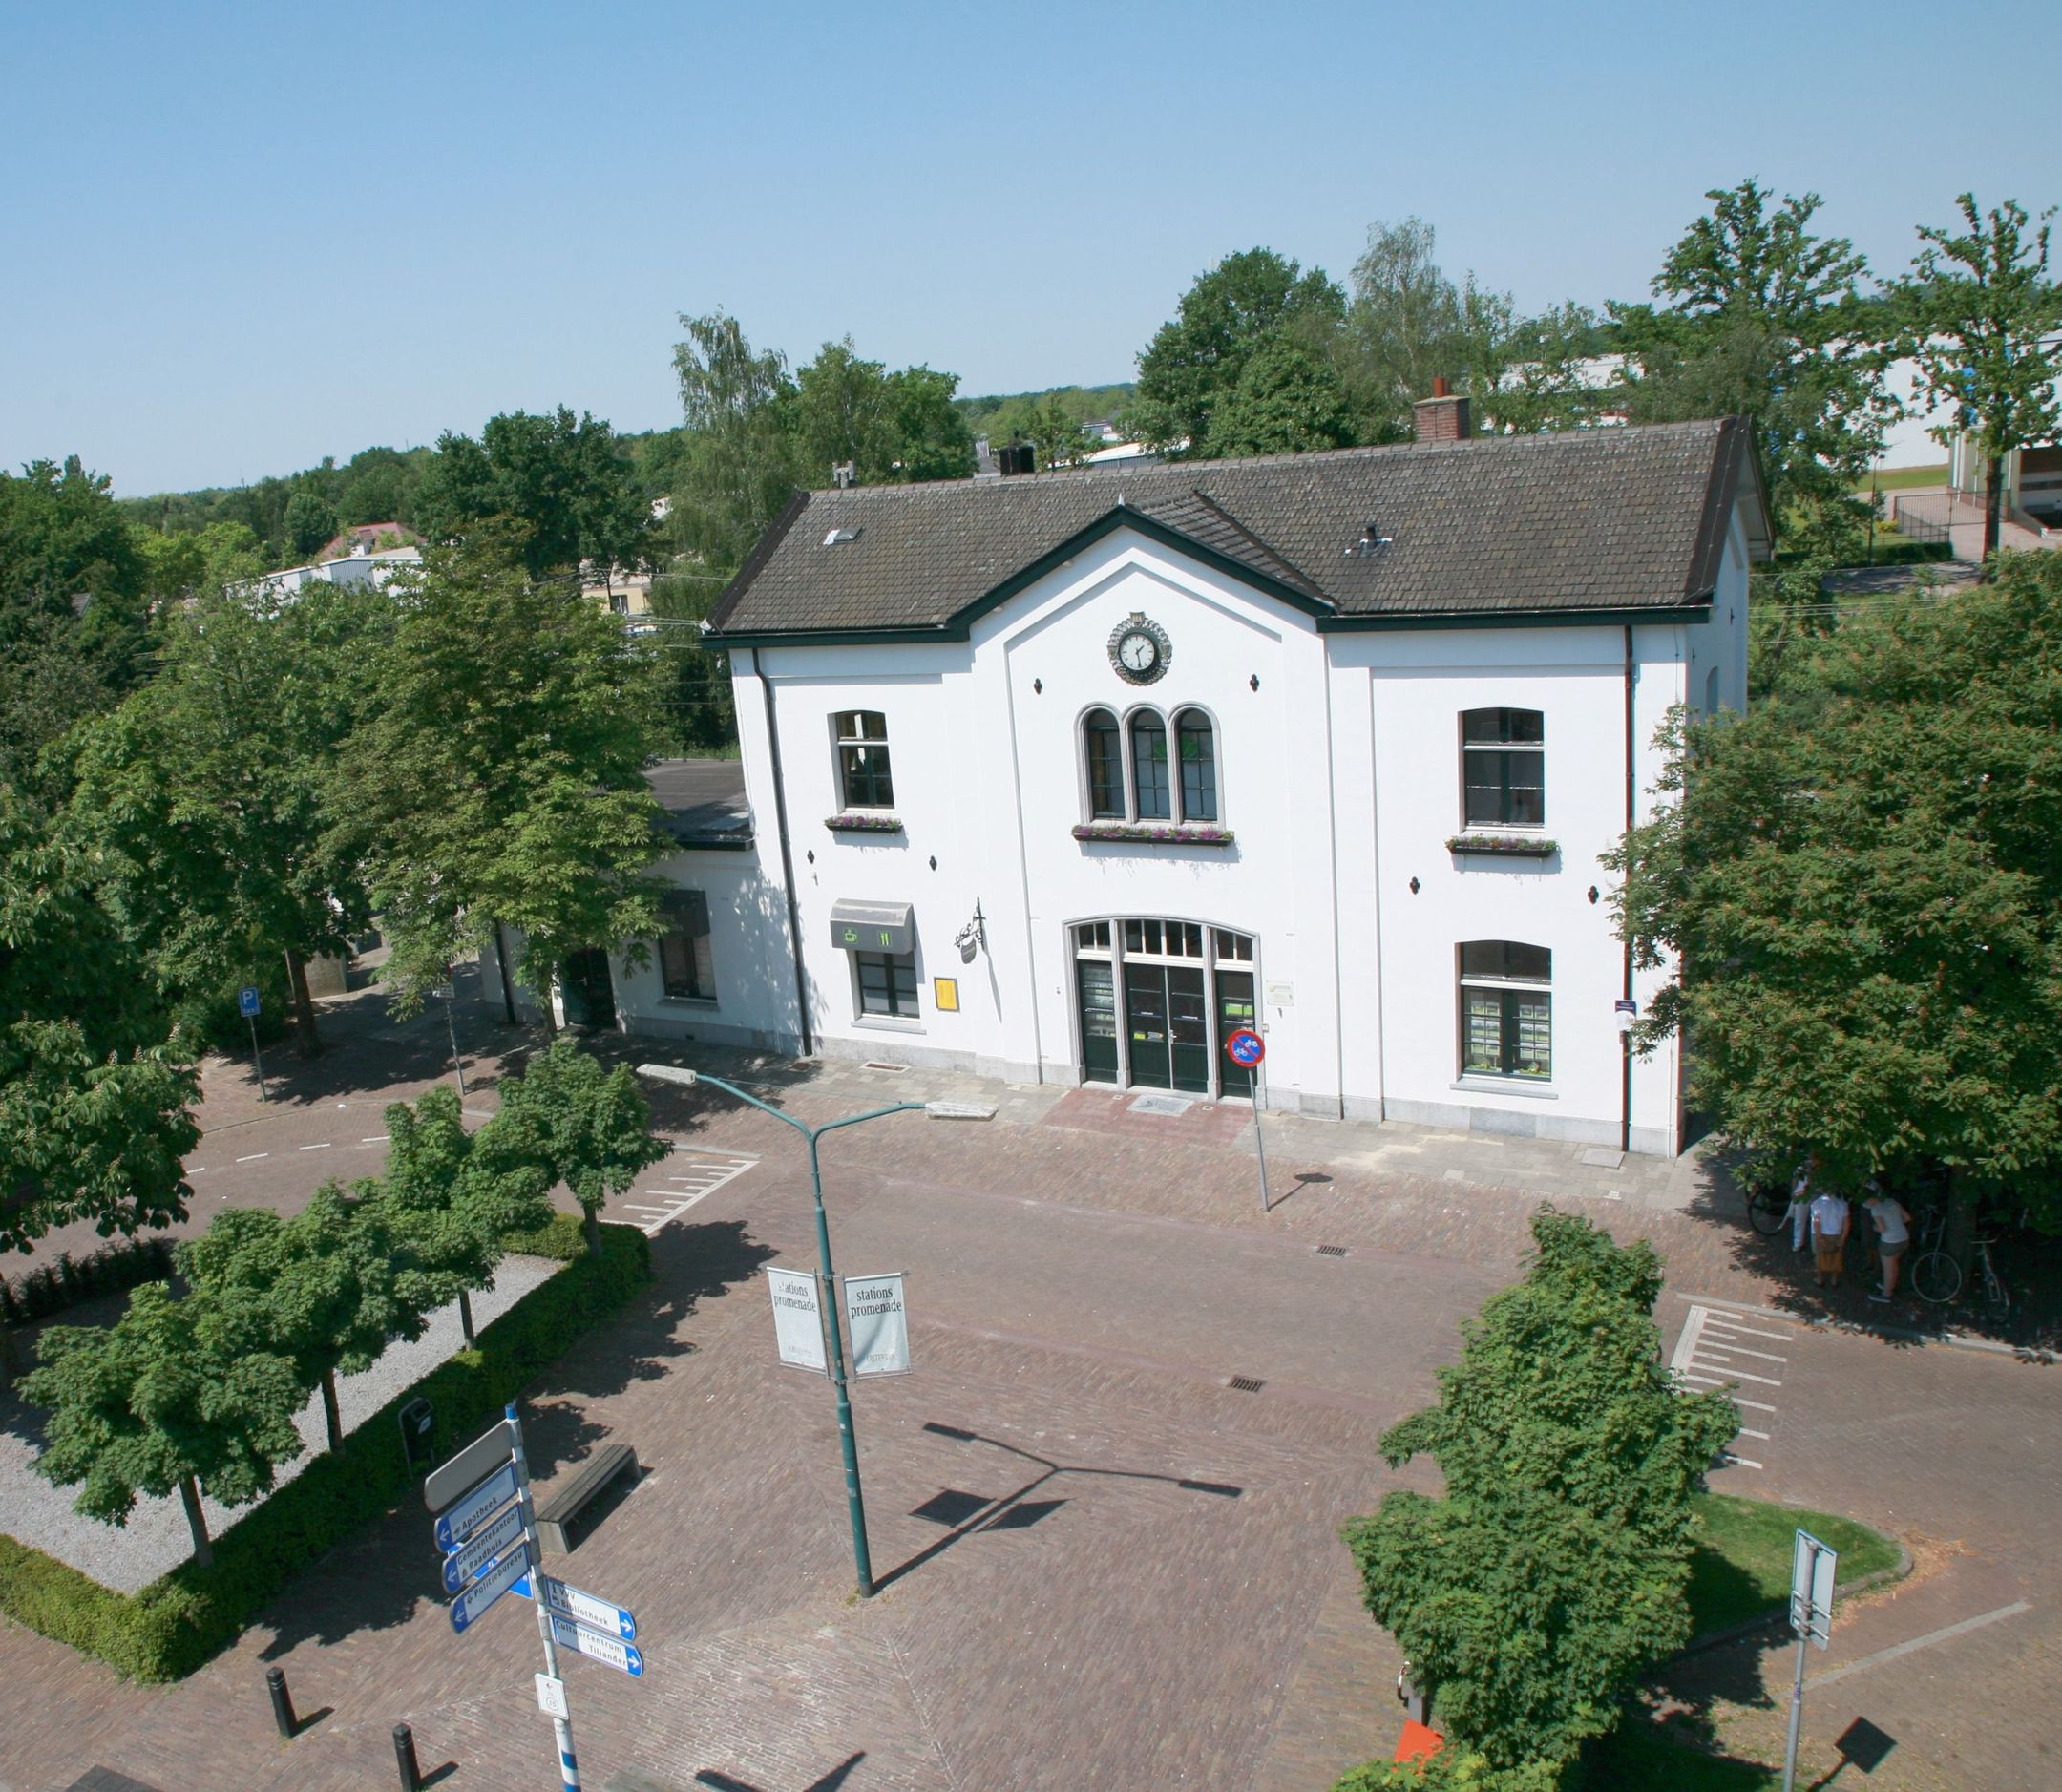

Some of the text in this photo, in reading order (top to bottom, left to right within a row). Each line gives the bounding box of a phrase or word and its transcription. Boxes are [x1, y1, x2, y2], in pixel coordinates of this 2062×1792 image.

[243, 991, 253, 1005] P
[778, 1281, 809, 1297] ations
[856, 1286, 894, 1301] stations
[774, 1295, 817, 1313] promenade
[851, 1299, 902, 1319] promenade
[462, 1497, 498, 1529] Apotheek
[457, 1510, 519, 1565] Gemeentekantoor
[469, 1539, 503, 1571] Raadhuis
[473, 1550, 523, 1597] Politiebureau
[556, 1619, 622, 1654] Cultuurcentrum
